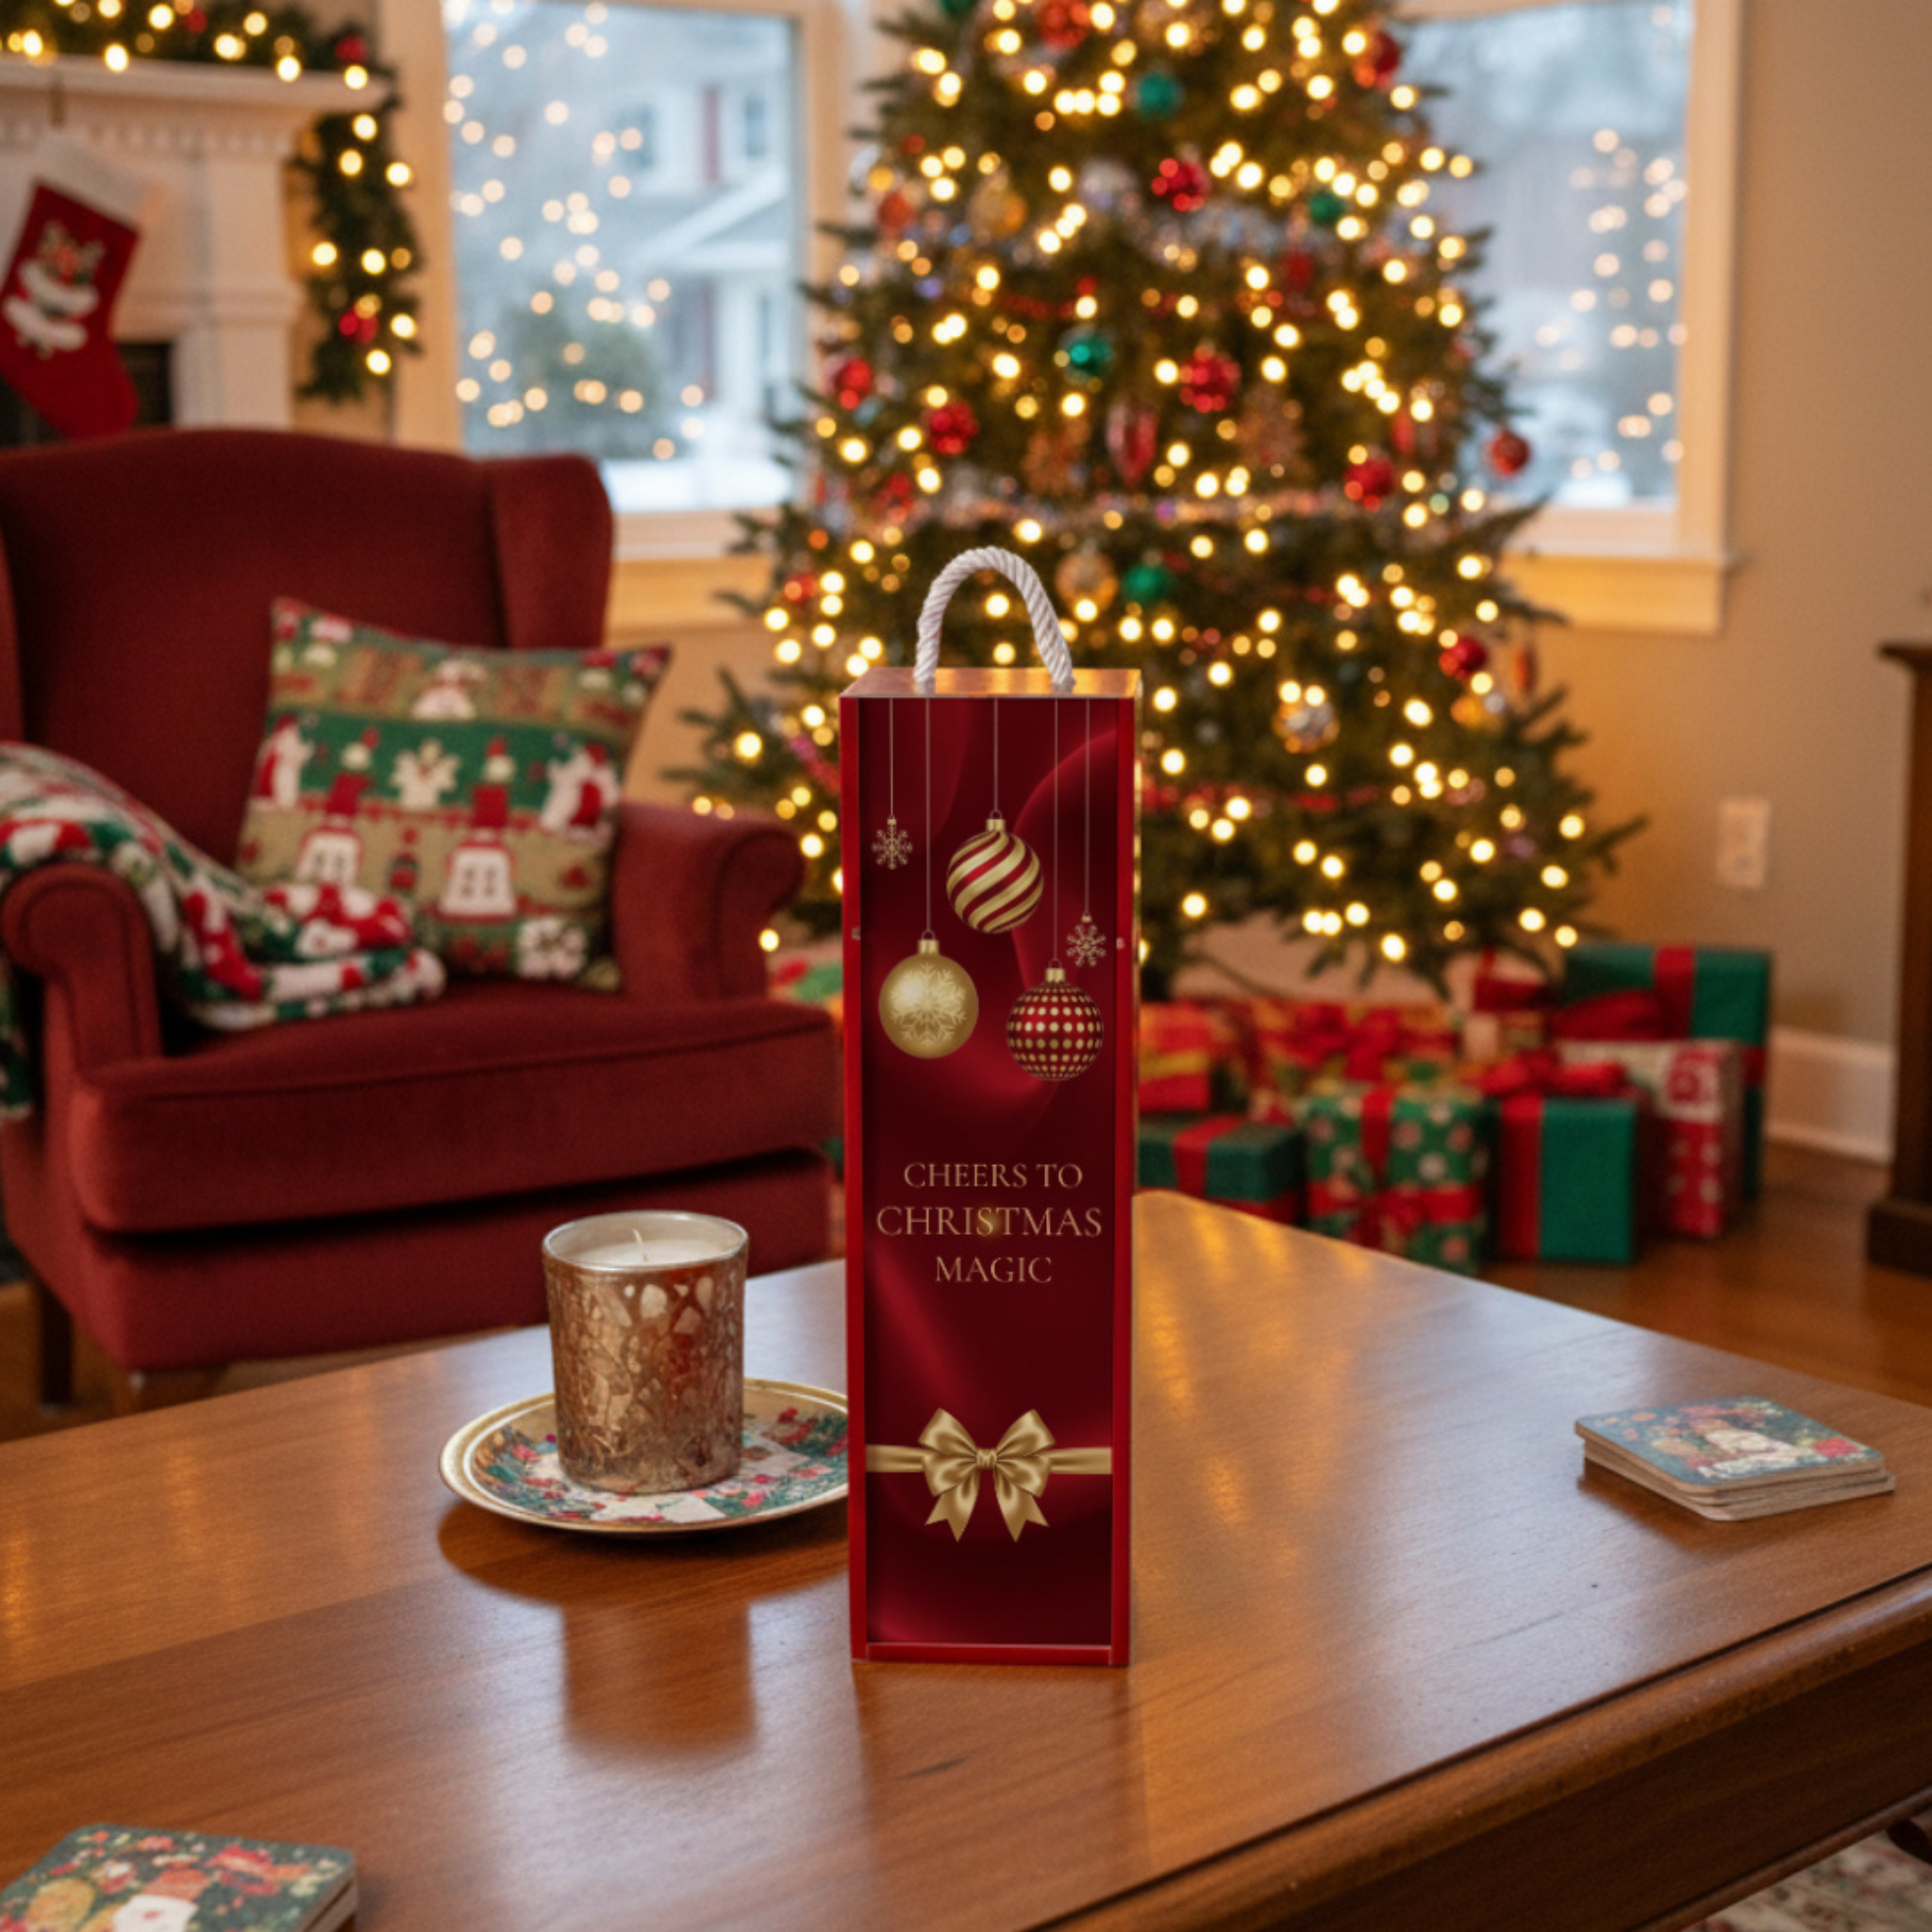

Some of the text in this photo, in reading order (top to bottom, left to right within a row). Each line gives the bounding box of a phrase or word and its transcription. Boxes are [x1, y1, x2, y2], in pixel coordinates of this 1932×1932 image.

[904, 1162, 1083, 1189] CHEERS TO
[876, 1206, 1102, 1237] CHRISTMAS
[935, 1257, 1052, 1283] MAGIC
